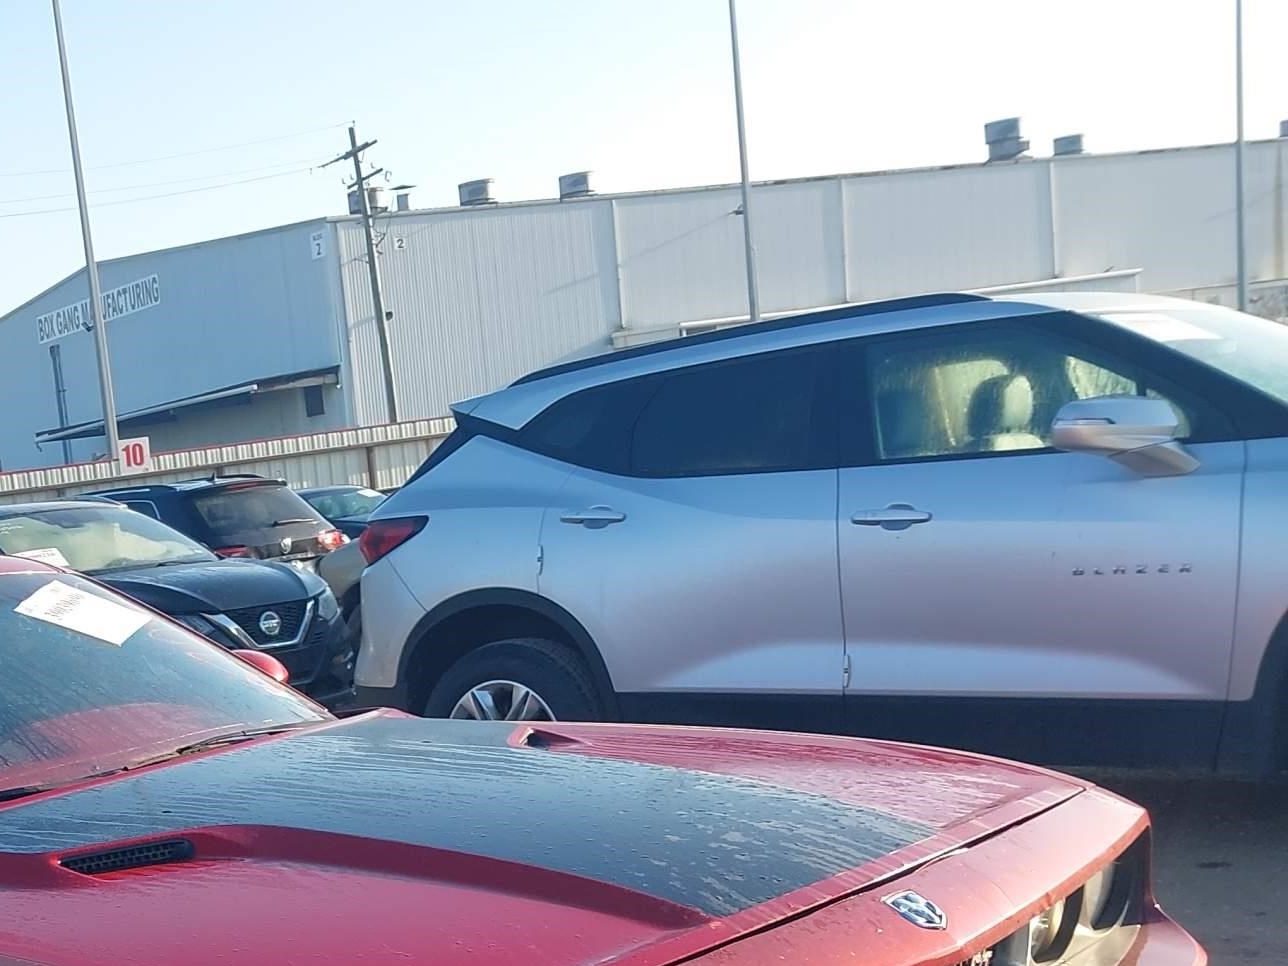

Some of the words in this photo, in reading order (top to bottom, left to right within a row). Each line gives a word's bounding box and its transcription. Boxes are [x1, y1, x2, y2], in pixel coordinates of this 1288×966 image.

[396, 238, 405, 249] 2
[38, 311, 57, 342] BOX
[56, 304, 82, 336] GANG
[81, 276, 159, 323] MUFACTURING
[121, 443, 145, 467] 10
[1071, 562, 1192, 576] BLAZER
